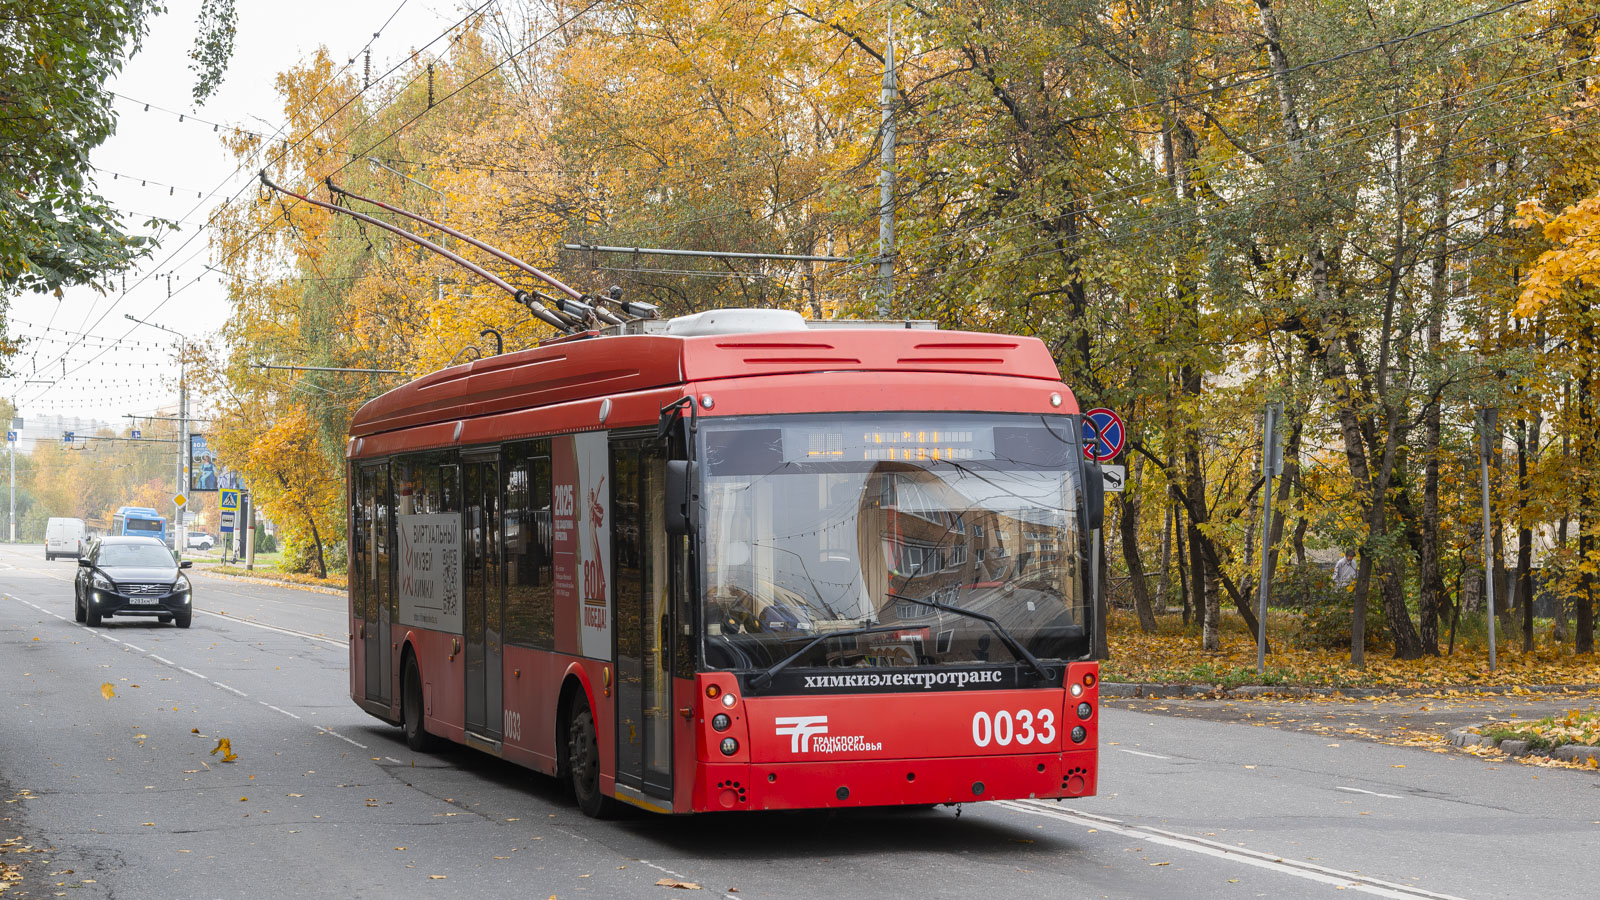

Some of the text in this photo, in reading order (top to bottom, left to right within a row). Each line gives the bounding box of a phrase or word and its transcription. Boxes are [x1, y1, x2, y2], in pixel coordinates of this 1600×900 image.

[555, 485, 573, 516] 2025
[413, 519, 457, 544] ВИРТУАЛЬНЫЙ
[414, 547, 433, 571] МУЗЕЙ
[414, 578, 434, 599] ХИМКИ
[584, 560, 596, 599] 80
[584, 606, 606, 631] ПОБЕДА!
[804, 670, 1002, 688] химкиэлектротранс
[504, 709, 520, 742] 0033
[972, 708, 1056, 748] 0033
[813, 736, 864, 745] ТРАНСПОРТ
[813, 742, 882, 753] ПОДМОСКОВЬЯ
